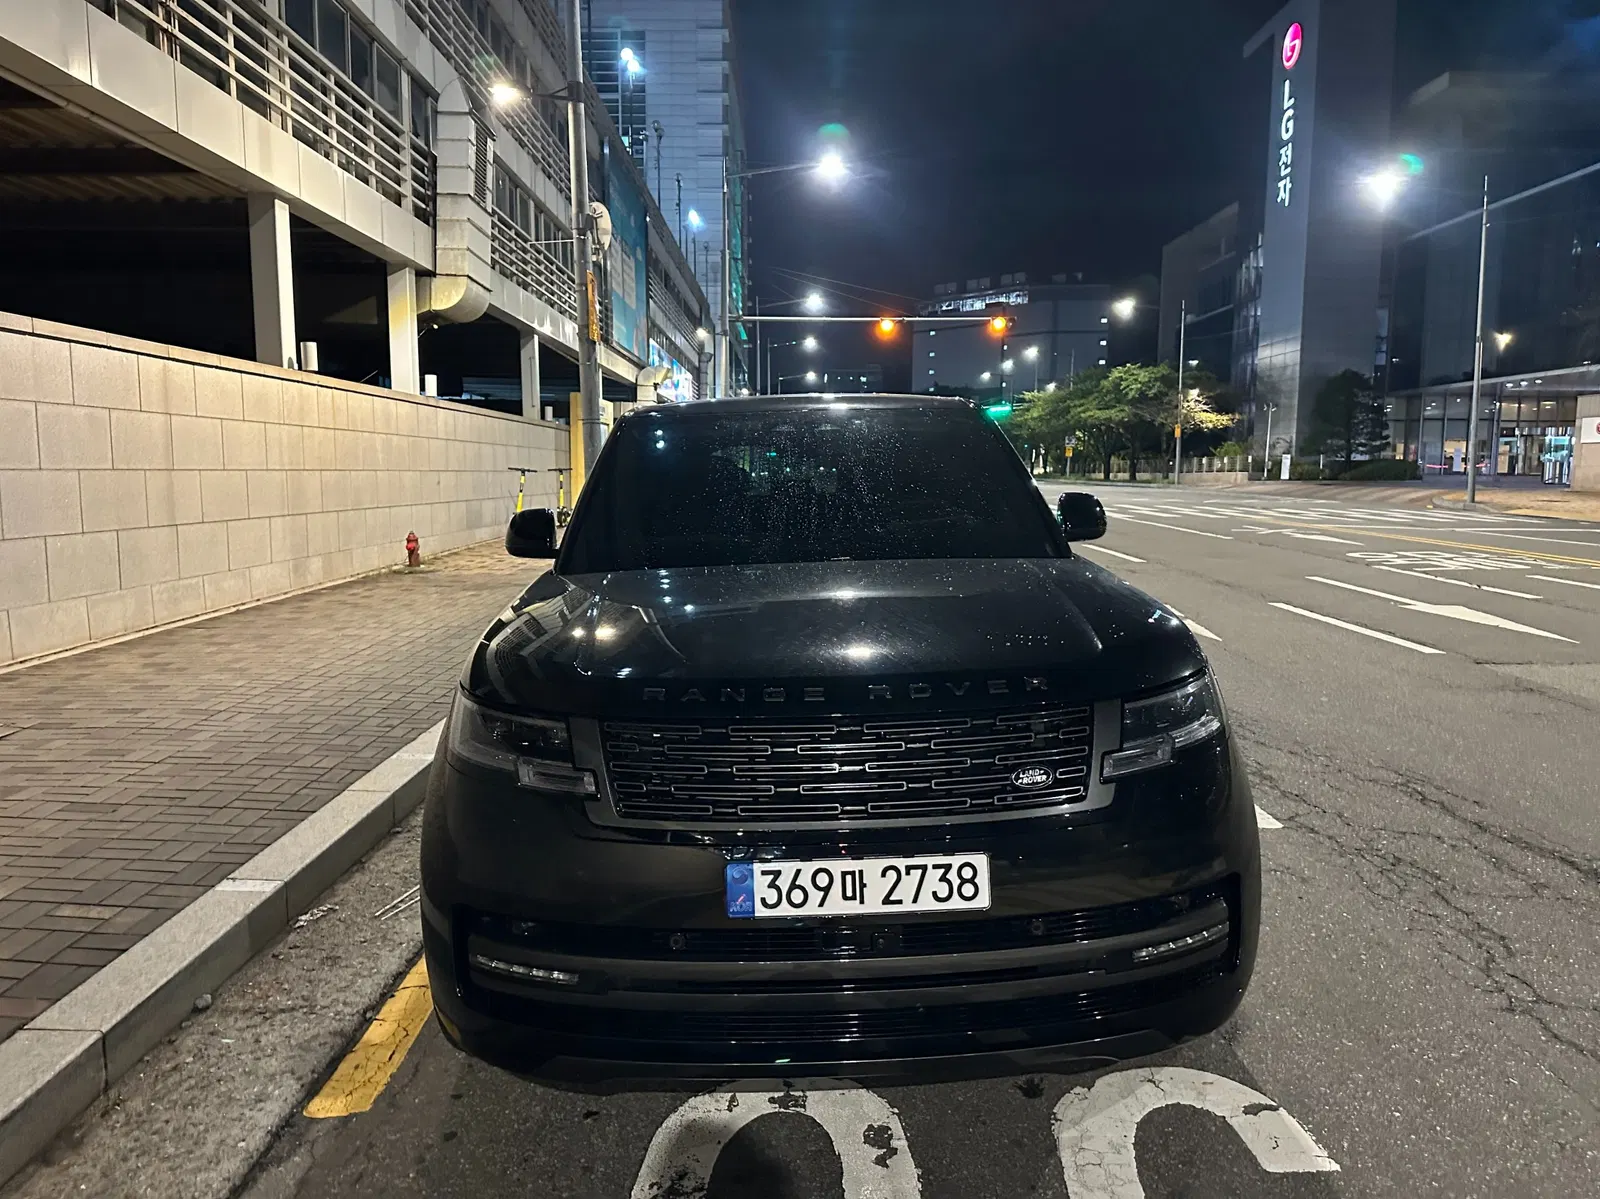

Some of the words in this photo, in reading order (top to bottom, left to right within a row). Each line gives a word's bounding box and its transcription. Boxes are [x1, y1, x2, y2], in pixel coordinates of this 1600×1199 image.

[1276, 79, 1295, 207] LG전자
[642, 686, 826, 702] RANGE
[867, 675, 1049, 700] ROVER
[1020, 768, 1040, 777] LAND
[1022, 775, 1047, 784] ROVER
[760, 868, 867, 909] 369마
[880, 861, 980, 906] 2738
[729, 901, 753, 912] KOR
